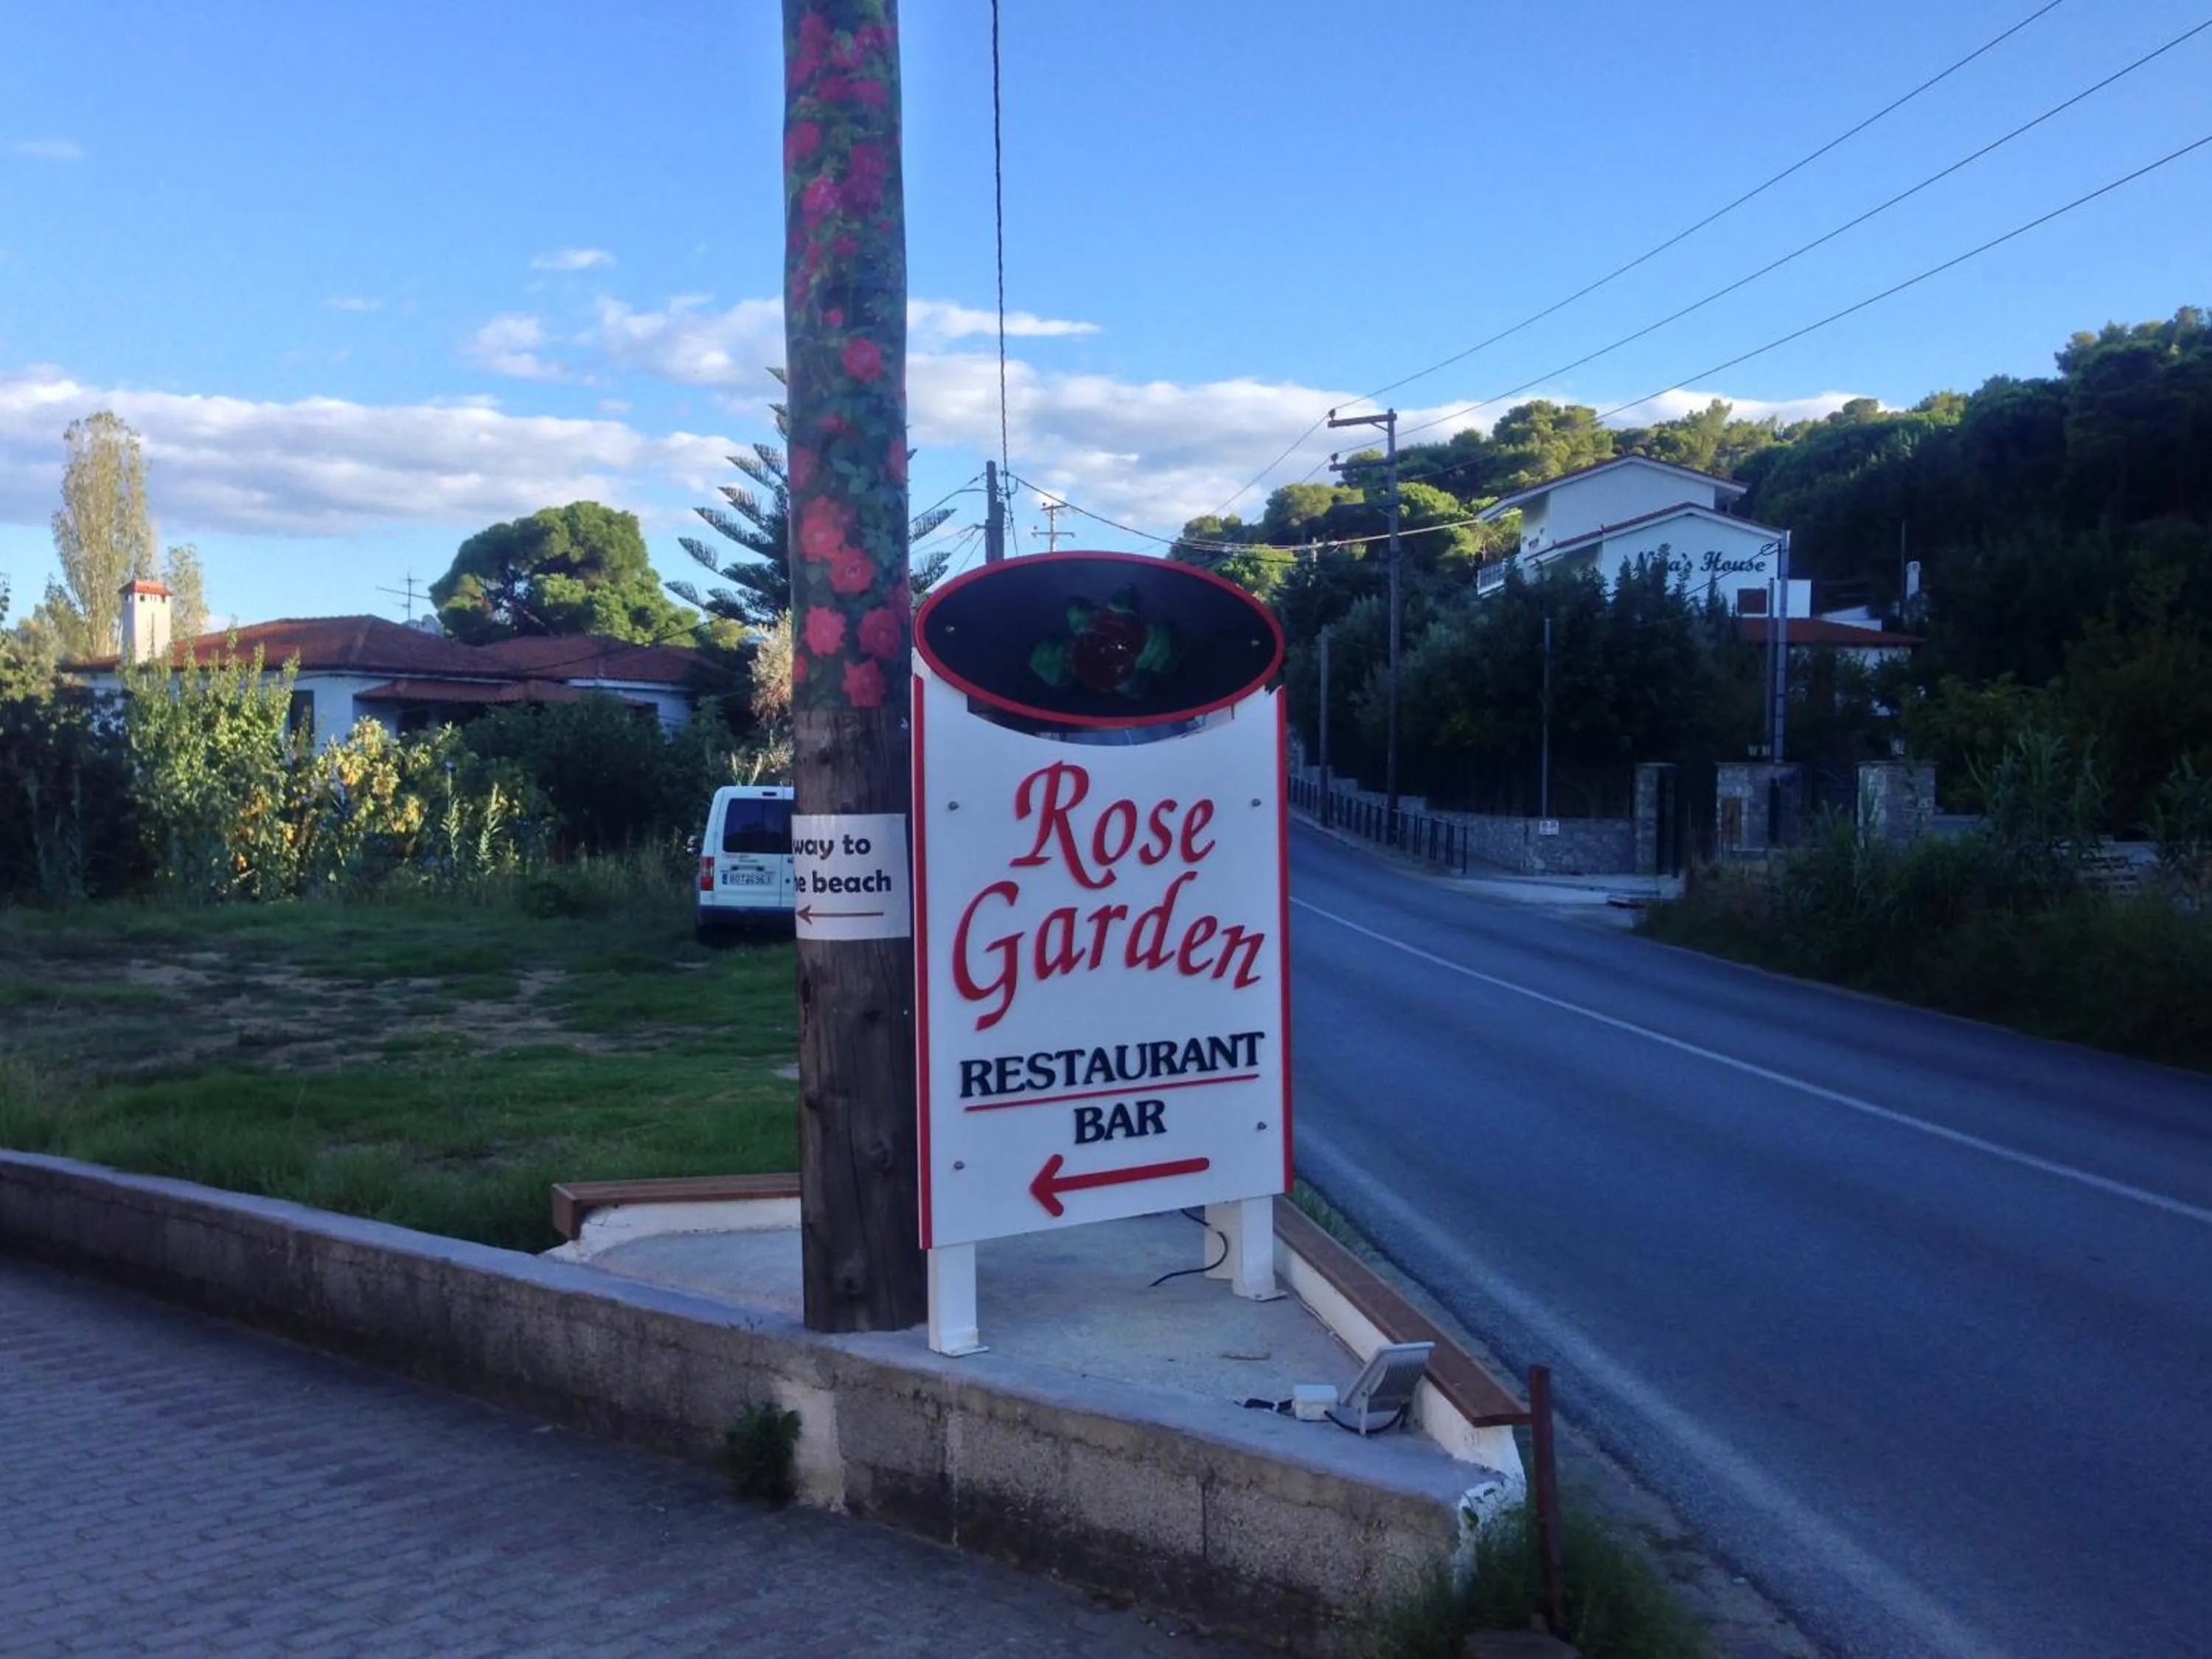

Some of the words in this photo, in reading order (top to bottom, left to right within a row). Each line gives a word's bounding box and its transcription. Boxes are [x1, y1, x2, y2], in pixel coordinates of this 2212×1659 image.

[1700, 551, 1767, 572] House
[793, 839, 834, 860] way
[842, 834, 871, 855] to
[1009, 760, 1217, 889] Rose
[812, 869, 891, 894] beach
[953, 871, 1265, 1031] Garden
[959, 1032, 1265, 1098] RESTAURANT
[1074, 1099, 1167, 1144] BAR
